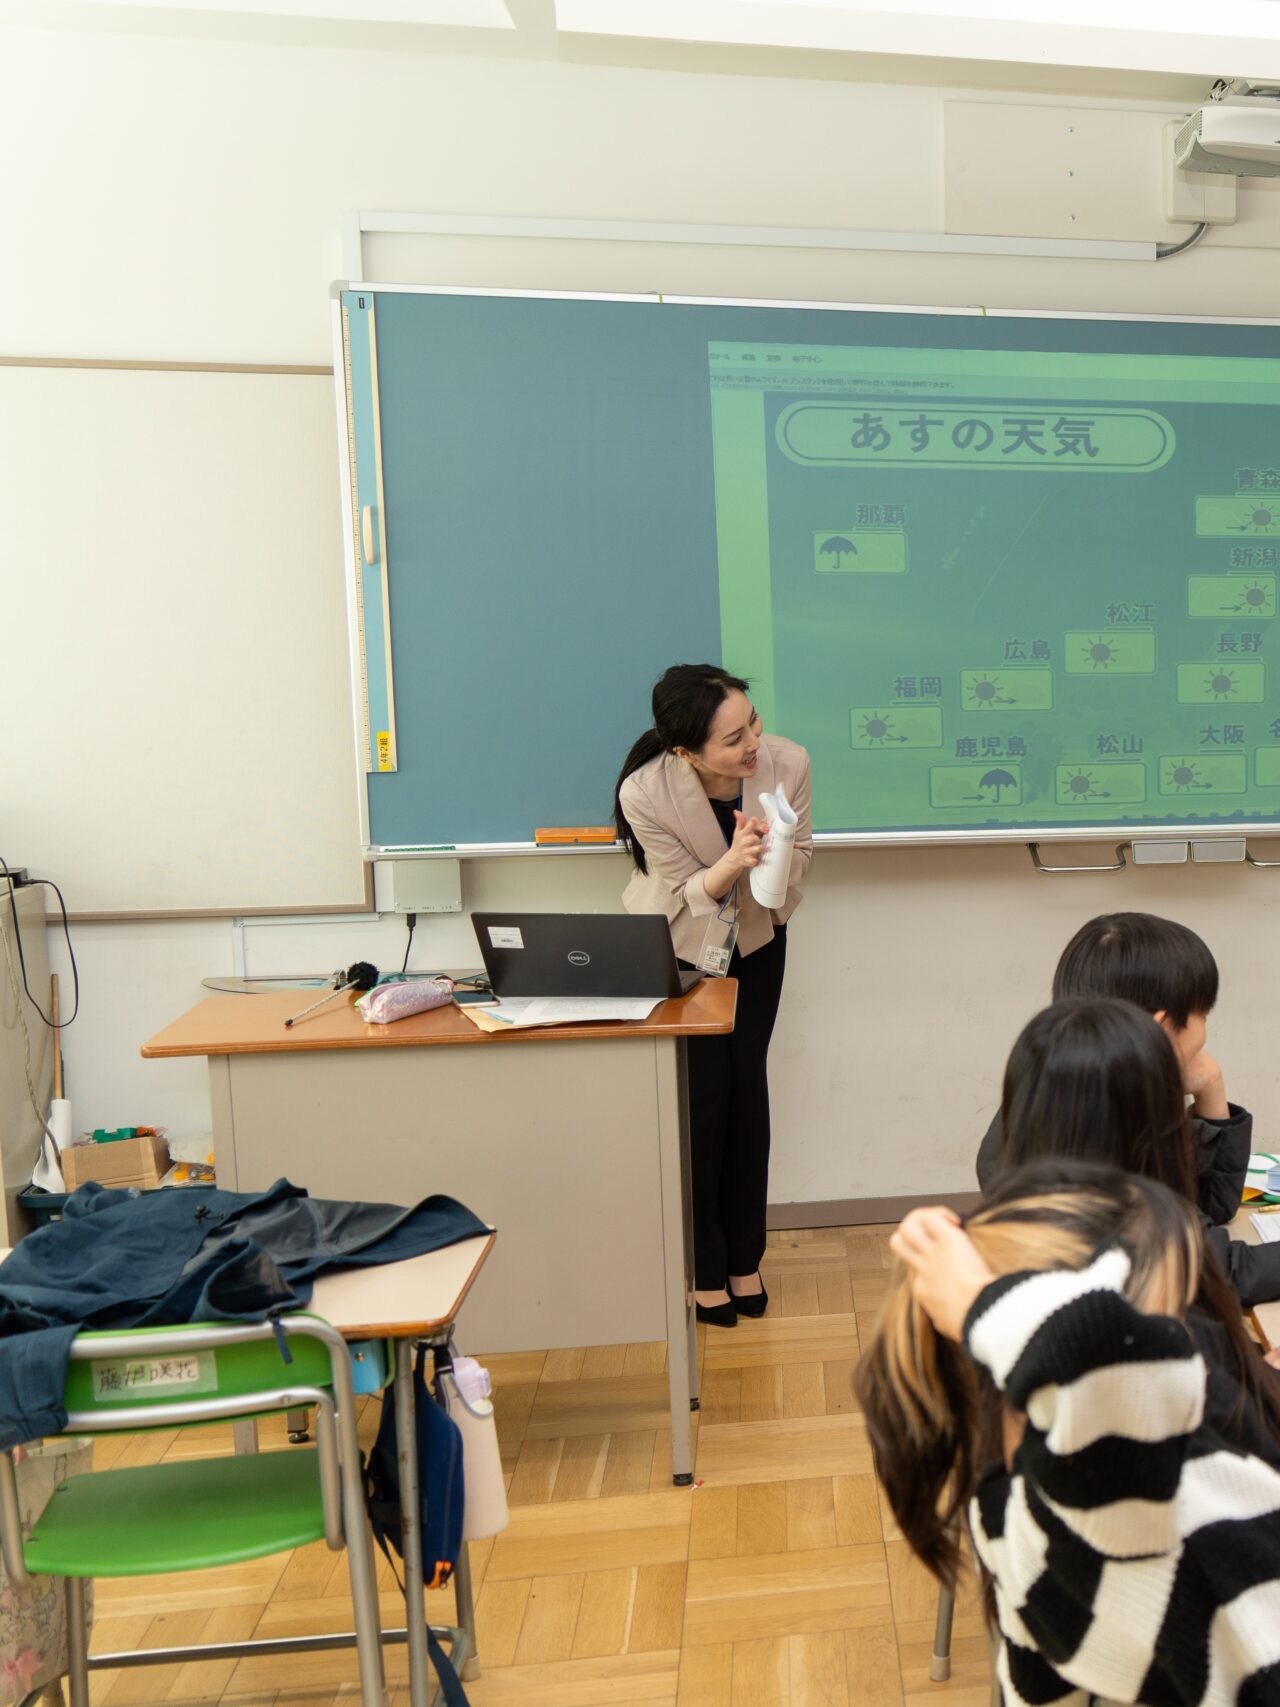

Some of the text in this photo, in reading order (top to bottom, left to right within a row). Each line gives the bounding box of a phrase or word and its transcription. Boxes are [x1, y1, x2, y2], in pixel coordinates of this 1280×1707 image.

[850, 412, 1100, 459] あすの天気
[855, 504, 906, 526] 那覇
[1230, 547, 1279, 569] 新潟
[1106, 603, 1155, 625] 松江
[1004, 639, 1052, 661] 広島
[1216, 633, 1263, 655] 長野
[893, 676, 943, 699] 福岡
[1096, 735, 1145, 756] 松山
[1200, 725, 1246, 746] 大阪
[379, 738, 388, 763] 4年2組
[955, 736, 1028, 760] 鹿児島
[570, 954, 588, 962] DELL
